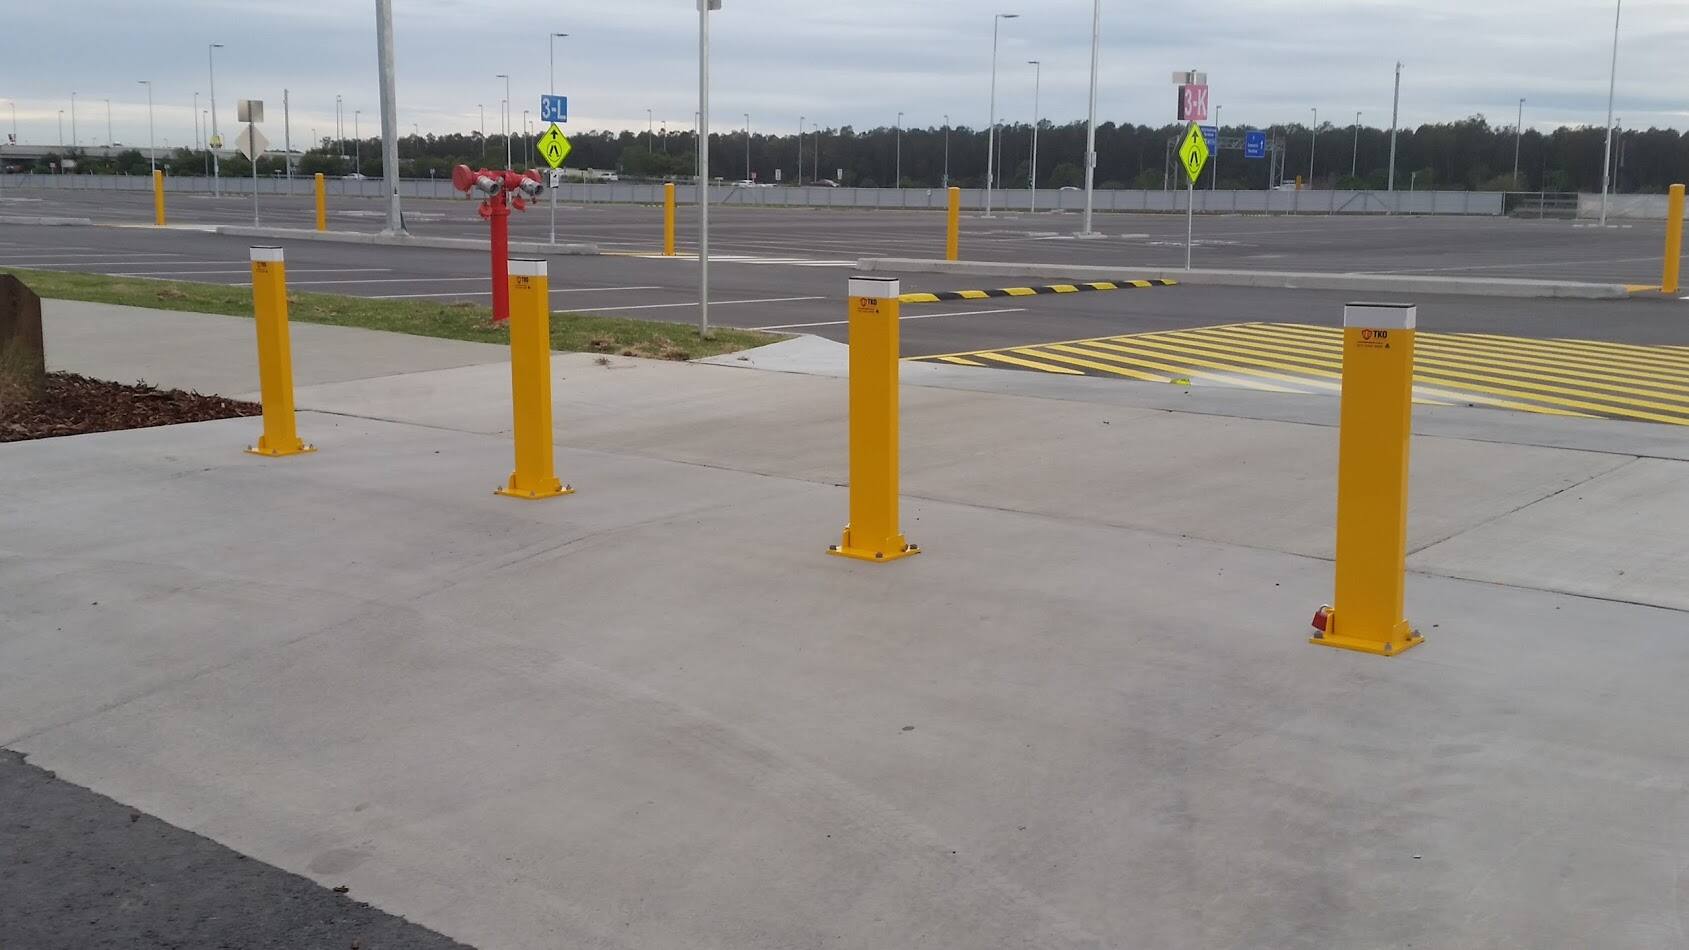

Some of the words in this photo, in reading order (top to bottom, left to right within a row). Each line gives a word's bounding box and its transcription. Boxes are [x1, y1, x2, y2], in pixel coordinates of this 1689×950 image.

[542, 98, 566, 119] 3-L
[1185, 89, 1207, 116] 3-K
[1373, 330, 1388, 338] TKO
